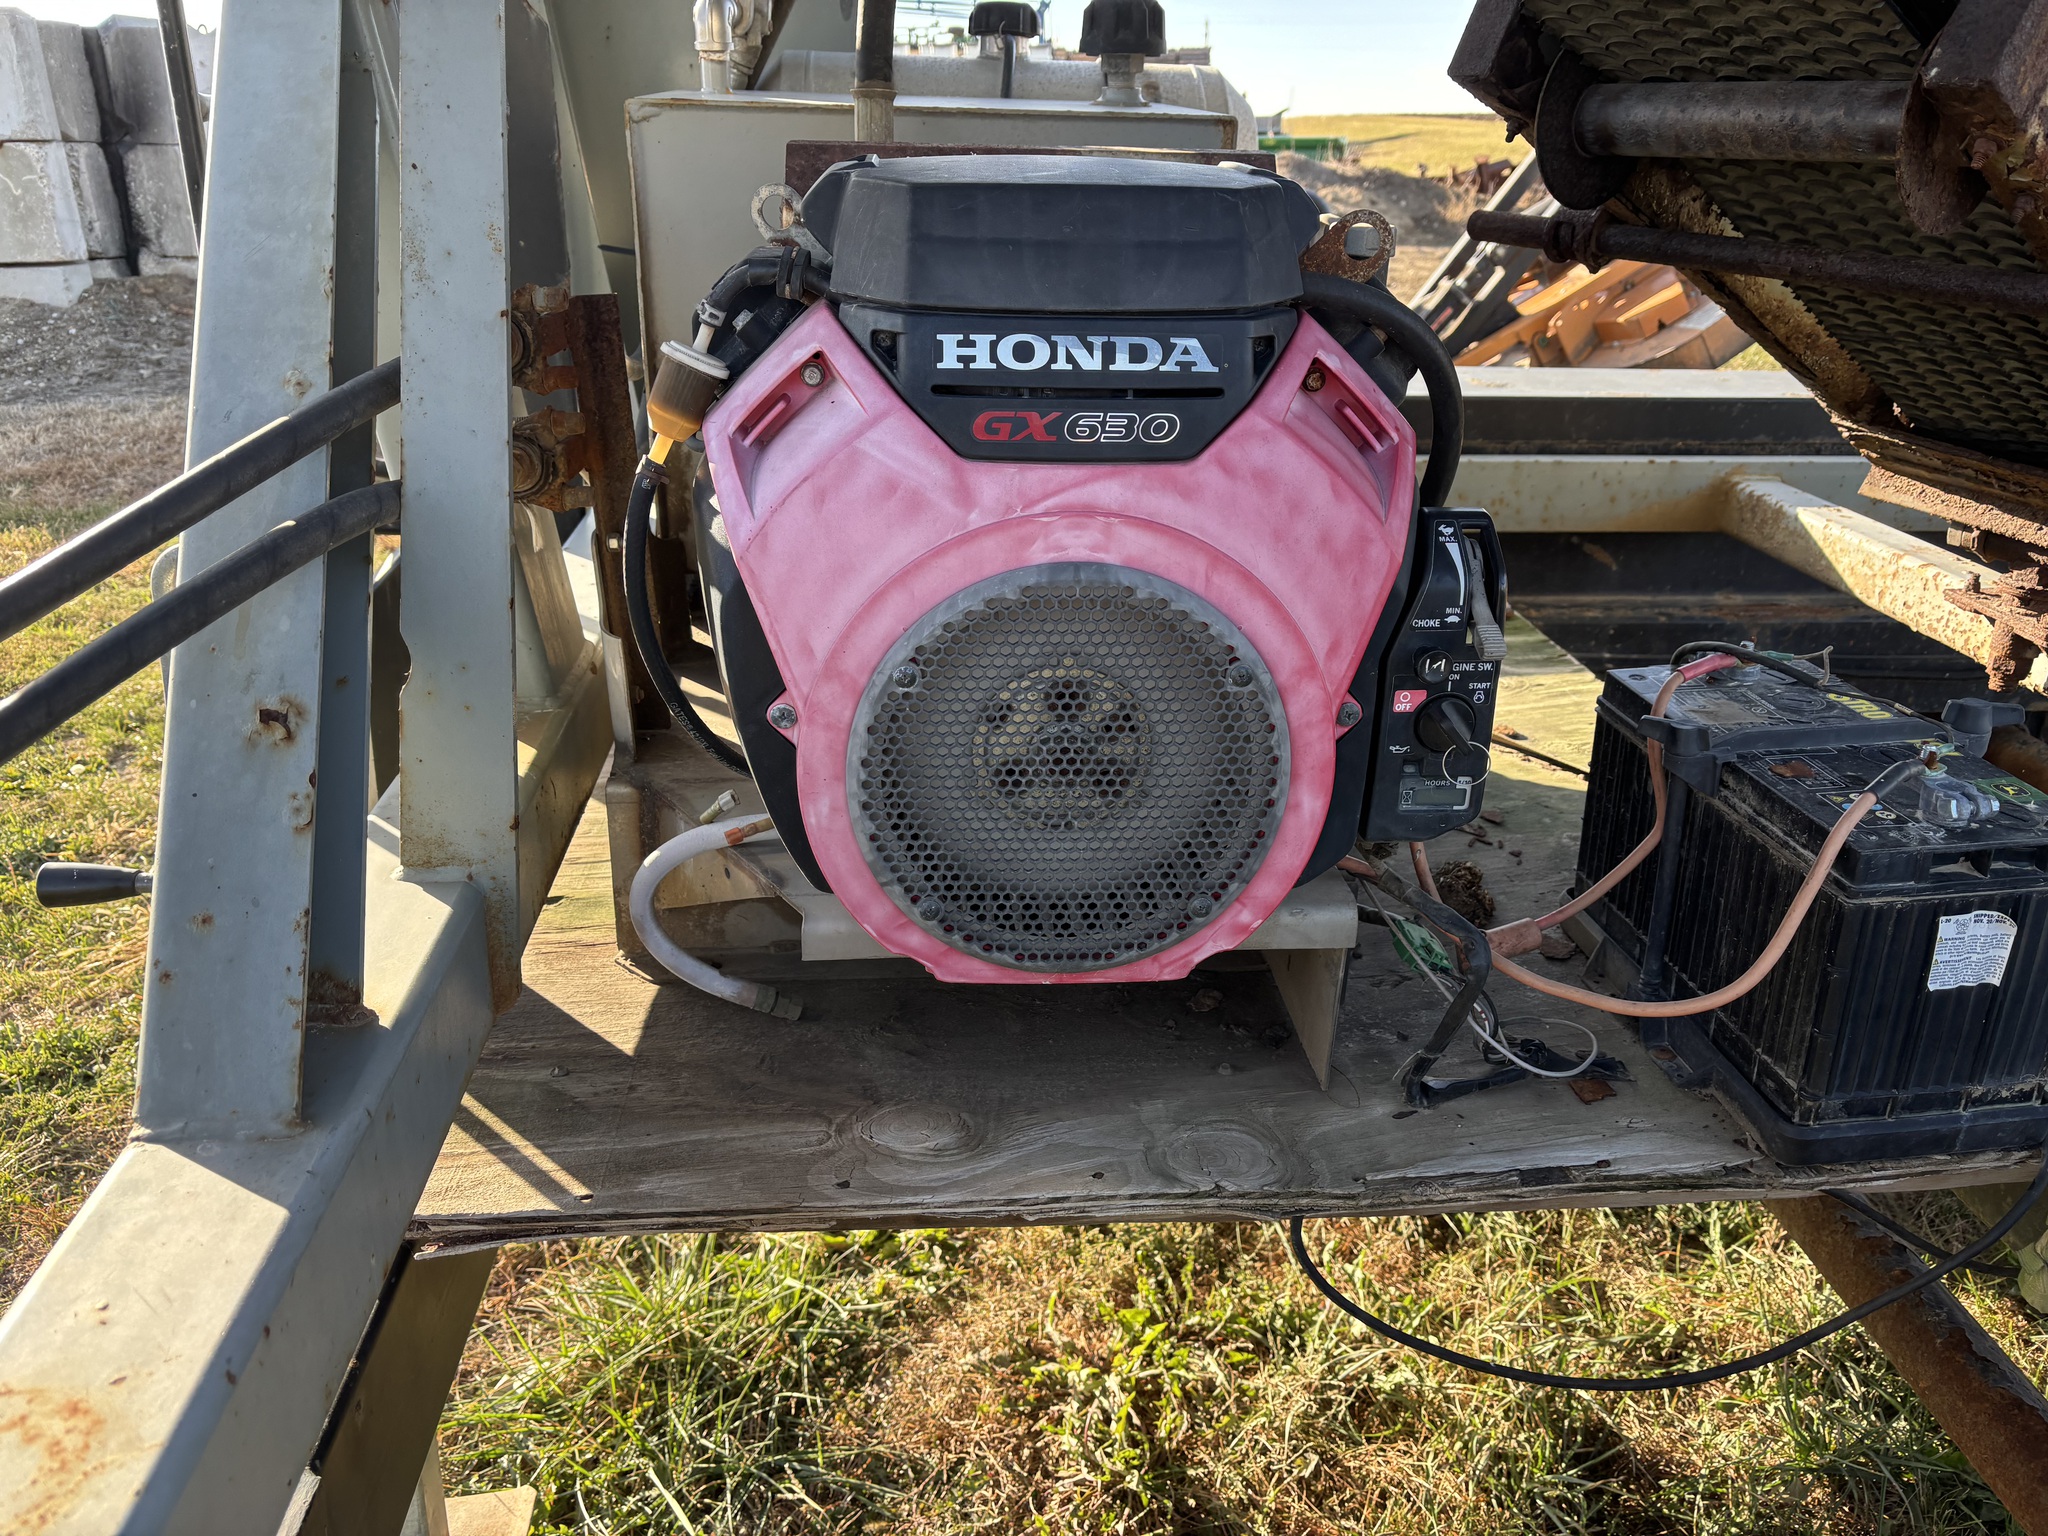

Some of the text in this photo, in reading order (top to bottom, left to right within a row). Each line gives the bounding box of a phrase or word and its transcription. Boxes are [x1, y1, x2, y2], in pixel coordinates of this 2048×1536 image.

[936, 333, 1220, 373] HONDA
[1412, 618, 1441, 628] CHOKE
[1452, 662, 1494, 672] GINE SW.
[1448, 673, 1460, 681] ON
[1394, 703, 1412, 711] OFF
[1825, 692, 1894, 720] STRO
